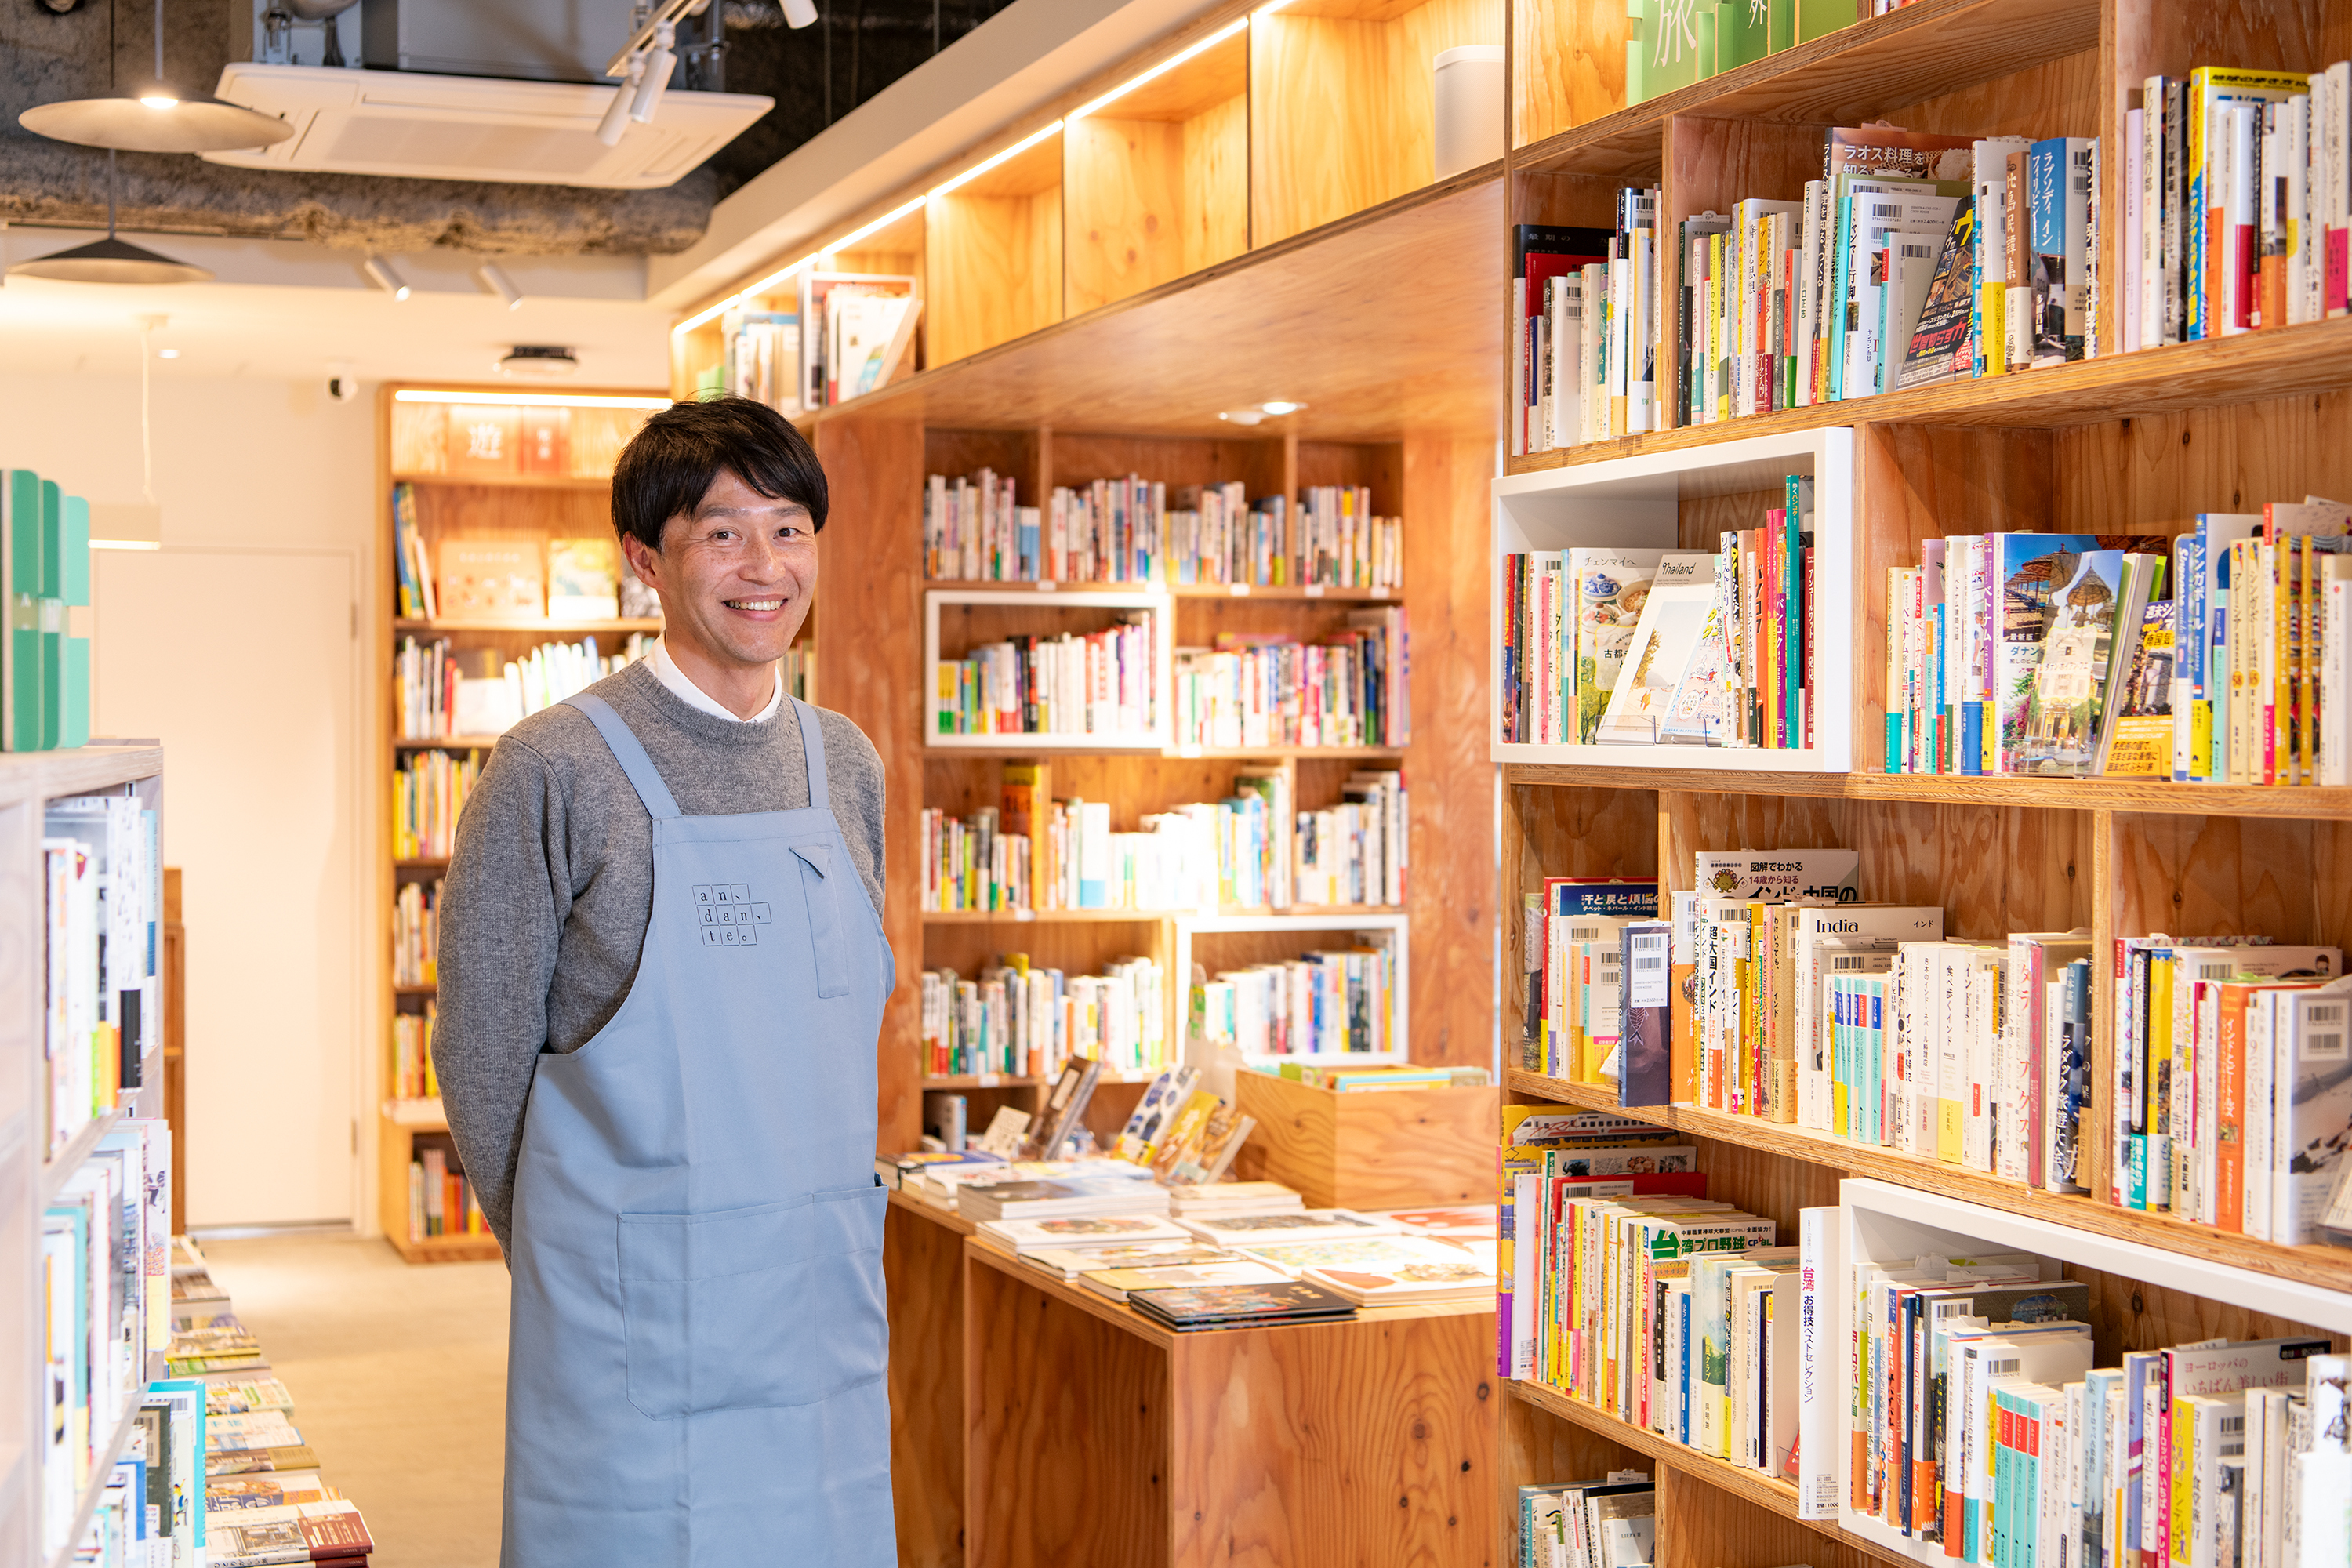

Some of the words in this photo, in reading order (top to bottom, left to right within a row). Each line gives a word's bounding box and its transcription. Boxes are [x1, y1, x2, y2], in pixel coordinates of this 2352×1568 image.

[1844, 145, 1926, 165] ラオス料理を
[2032, 155, 2041, 218] フィリピン
[2042, 151, 2055, 215] ラプソディ
[2006, 172, 2018, 280] 比島民譚集
[2042, 220, 2054, 247] イン
[1748, 223, 1758, 295] 降りる思想
[1847, 208, 1857, 299] ミャンマー行脚
[1764, 285, 1773, 324] ブータン
[1909, 321, 1968, 354] 世間知らず力
[1584, 556, 1637, 567] チェンマイへ
[1662, 562, 1697, 575] Thailand
[2177, 547, 2189, 608] Singapore
[2193, 543, 2206, 631] シンガポール
[2231, 572, 2242, 630] マレーシア
[1776, 598, 1784, 649] バンコク
[1983, 586, 1993, 642] ベトナム
[2009, 633, 2034, 641] 最新版
[2010, 646, 2039, 657] ダナン
[1748, 875, 1800, 884] 14歳から知る
[1750, 862, 1804, 873] 図解でわかる
[1816, 919, 1860, 933] India
[1913, 920, 1934, 929] インド
[1708, 925, 1719, 1014] 超大国インド
[1945, 964, 1955, 1047] 食べ歩くインド
[1651, 1229, 1745, 1260] 台湾プロ野球
[1802, 1266, 1816, 1292] 台湾
[1802, 1295, 1816, 1403] お得技ベストセレクション
[2184, 1358, 2249, 1373] ヨーロッパの
[2184, 1371, 2289, 1395] いちばん美しい街
[2159, 1416, 2169, 1474] ヨーロッパの
[2158, 1477, 2168, 1523] いちばん
